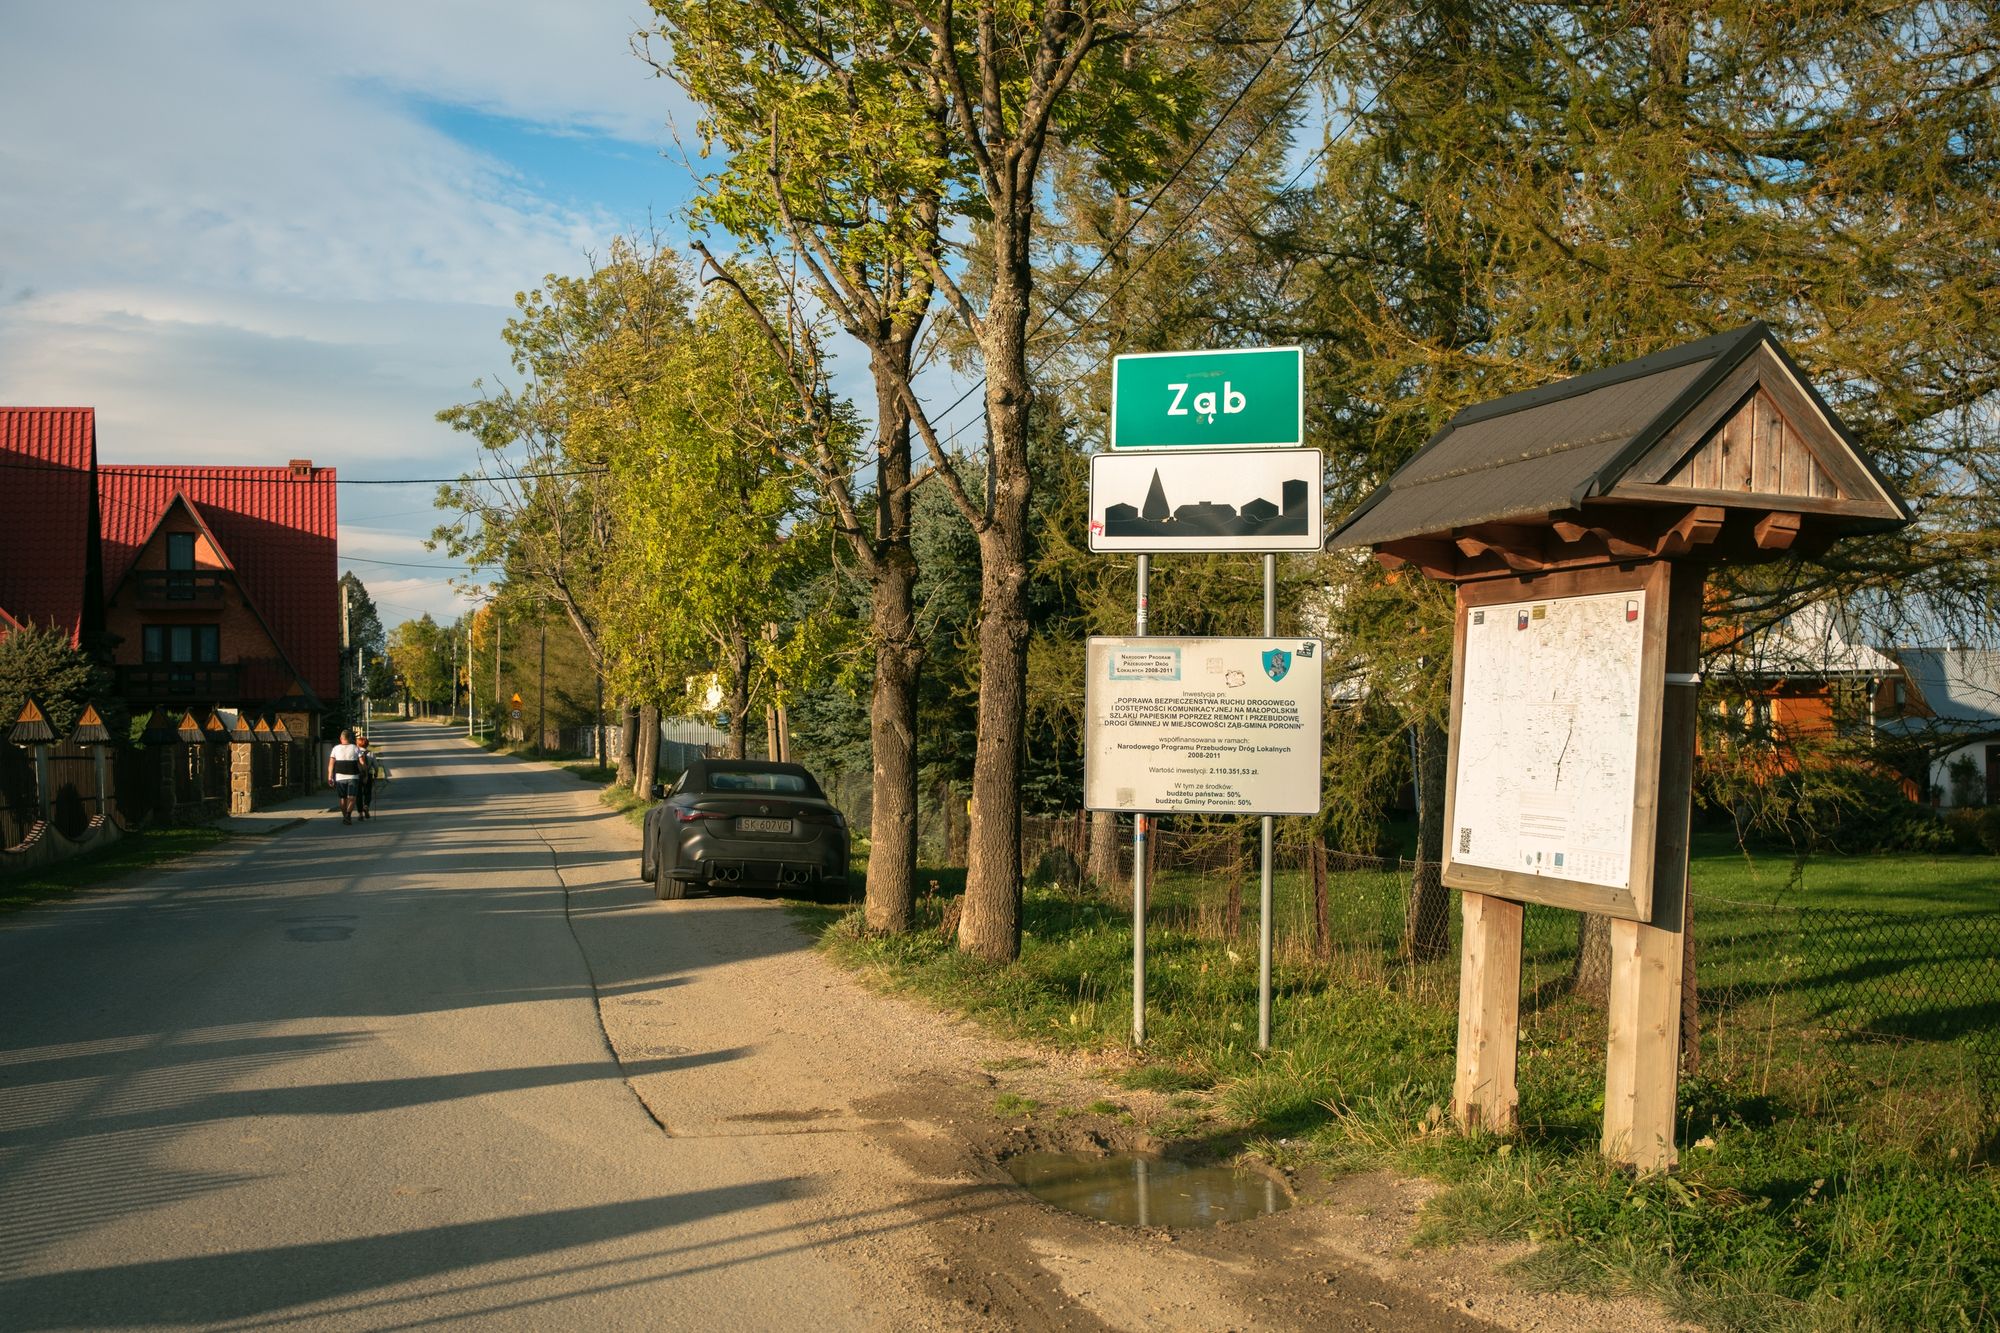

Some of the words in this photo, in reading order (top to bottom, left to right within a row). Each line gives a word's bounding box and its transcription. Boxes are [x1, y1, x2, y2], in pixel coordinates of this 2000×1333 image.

[1167, 381, 1246, 424] Ząb
[1154, 697, 1218, 705] BEZPIECZEŃSTWA
[1196, 744, 1237, 752] Przebudowy
[1238, 745, 1255, 753] Dróg
[1184, 798, 1205, 806] Gminy
[744, 820, 756, 829] SK
[760, 820, 789, 831] 607VG
